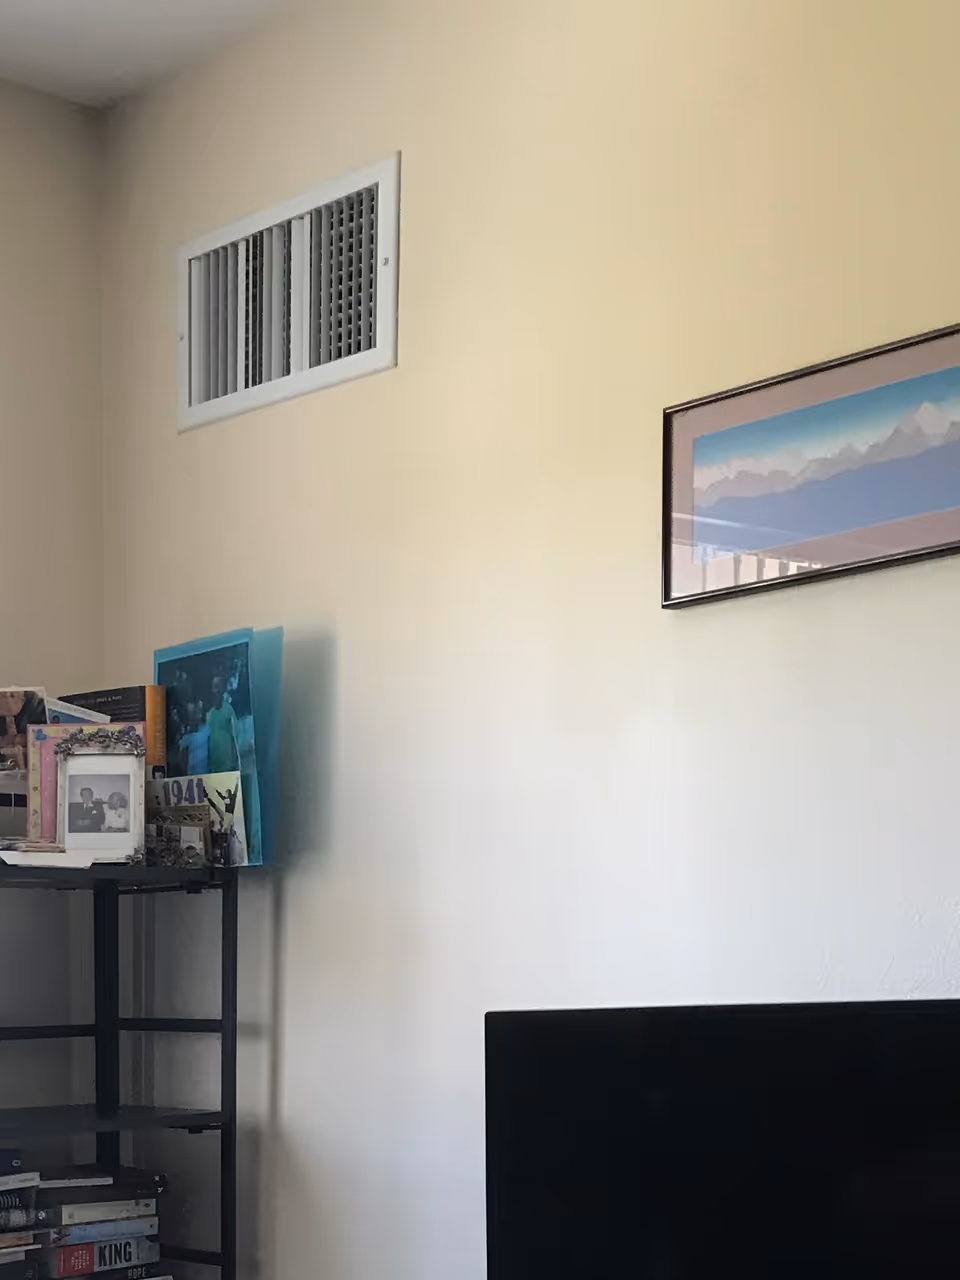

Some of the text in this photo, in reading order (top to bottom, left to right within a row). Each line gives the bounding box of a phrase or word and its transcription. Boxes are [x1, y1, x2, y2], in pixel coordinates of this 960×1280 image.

[162, 777, 206, 806] 1941
[98, 1241, 132, 1267] KING
[127, 1266, 147, 1279] HOPE
